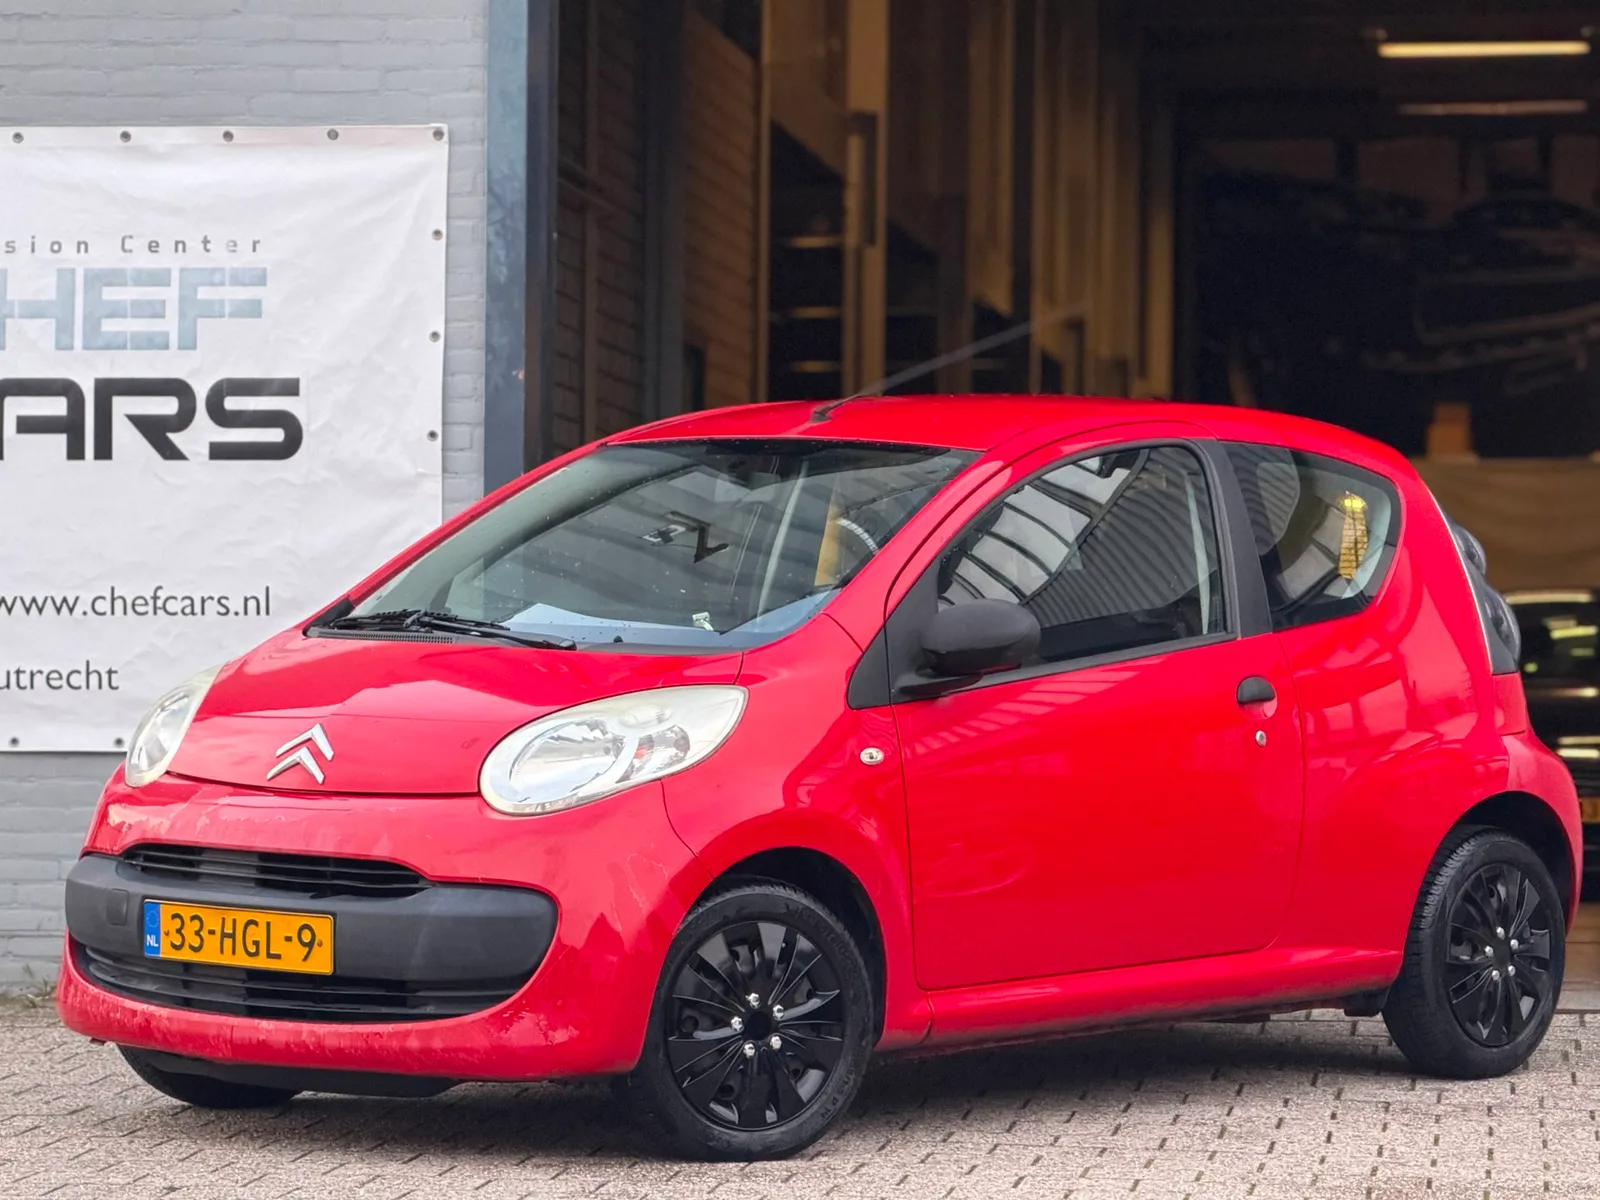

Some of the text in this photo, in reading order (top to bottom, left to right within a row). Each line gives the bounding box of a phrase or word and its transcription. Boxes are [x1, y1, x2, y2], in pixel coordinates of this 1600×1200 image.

[4, 235, 261, 254] sion Center
[146, 934, 159, 947] NL
[170, 912, 317, 962] 33-HGL-9
